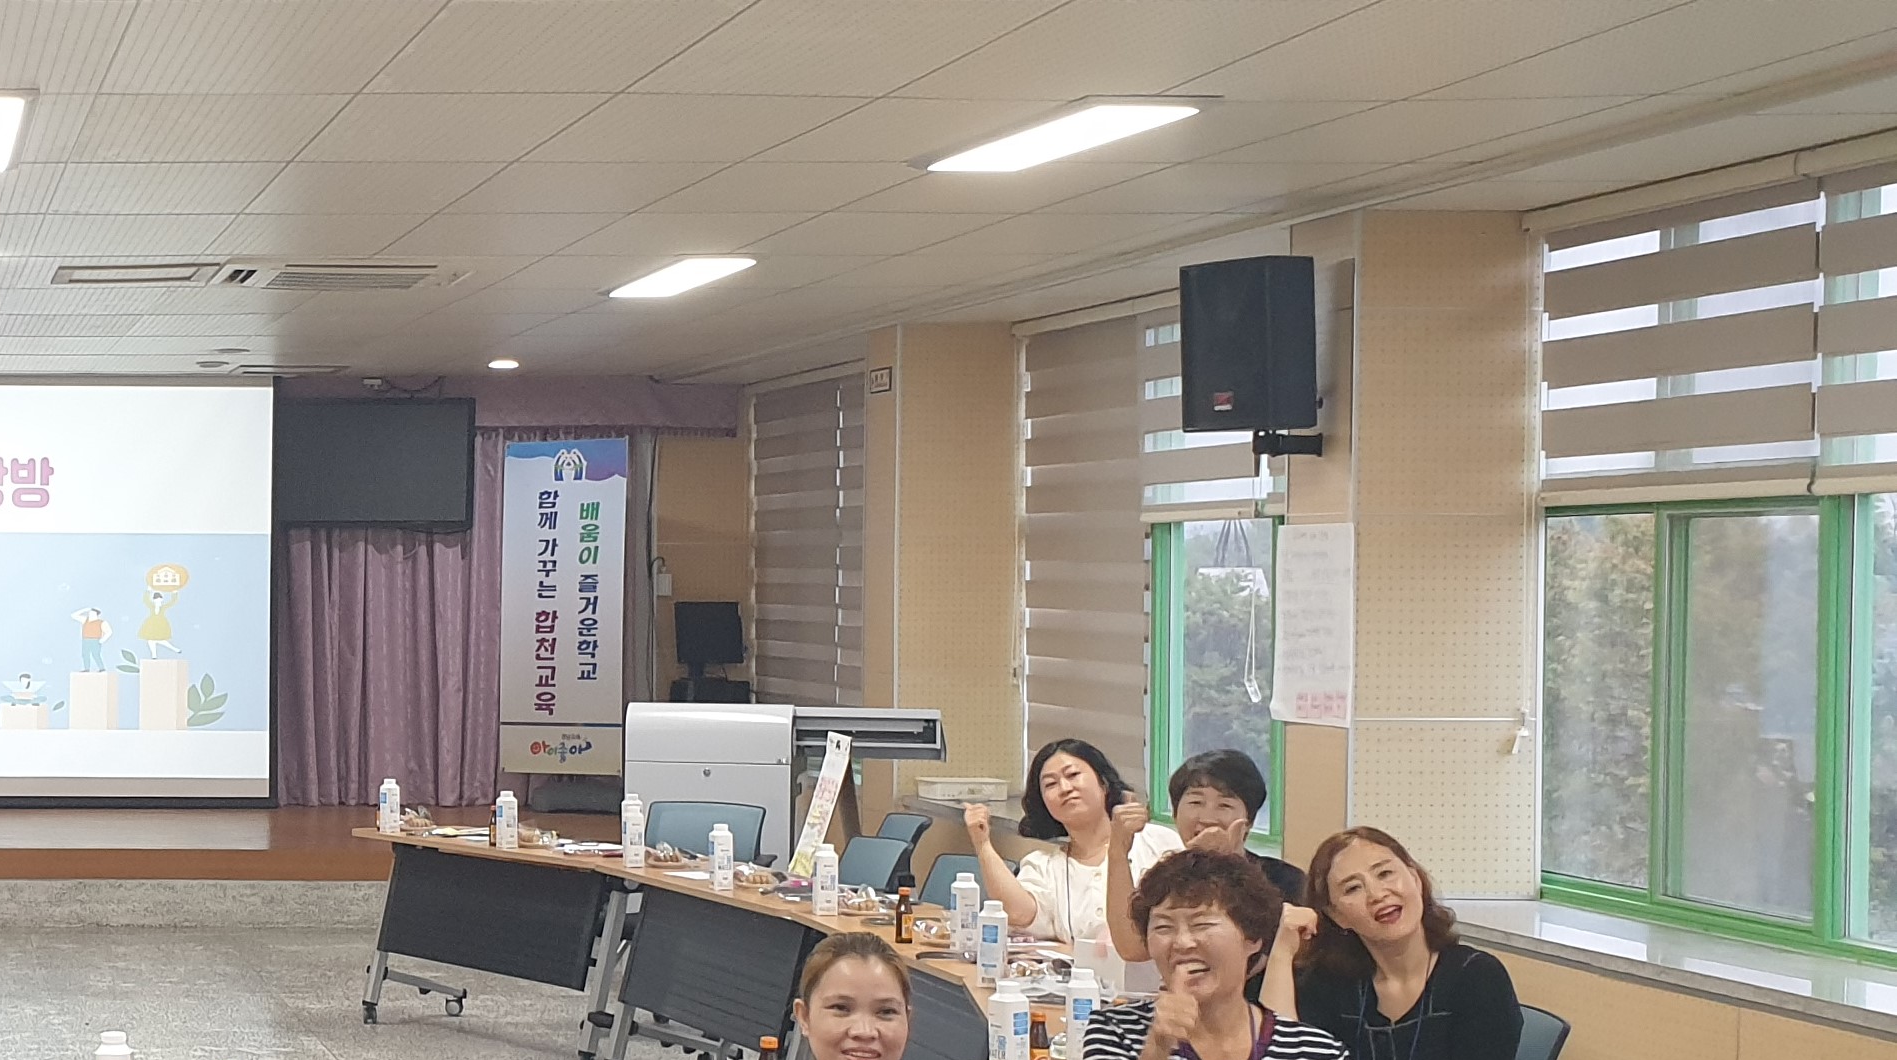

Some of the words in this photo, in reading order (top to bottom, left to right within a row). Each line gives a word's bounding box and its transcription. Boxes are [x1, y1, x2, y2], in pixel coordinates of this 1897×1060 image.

[537, 489, 560, 530] 함께
[578, 501, 601, 565] 배움이
[536, 538, 559, 599] 가꾸는
[533, 610, 559, 716] 합천교육
[530, 740, 593, 764] 아이좋아
